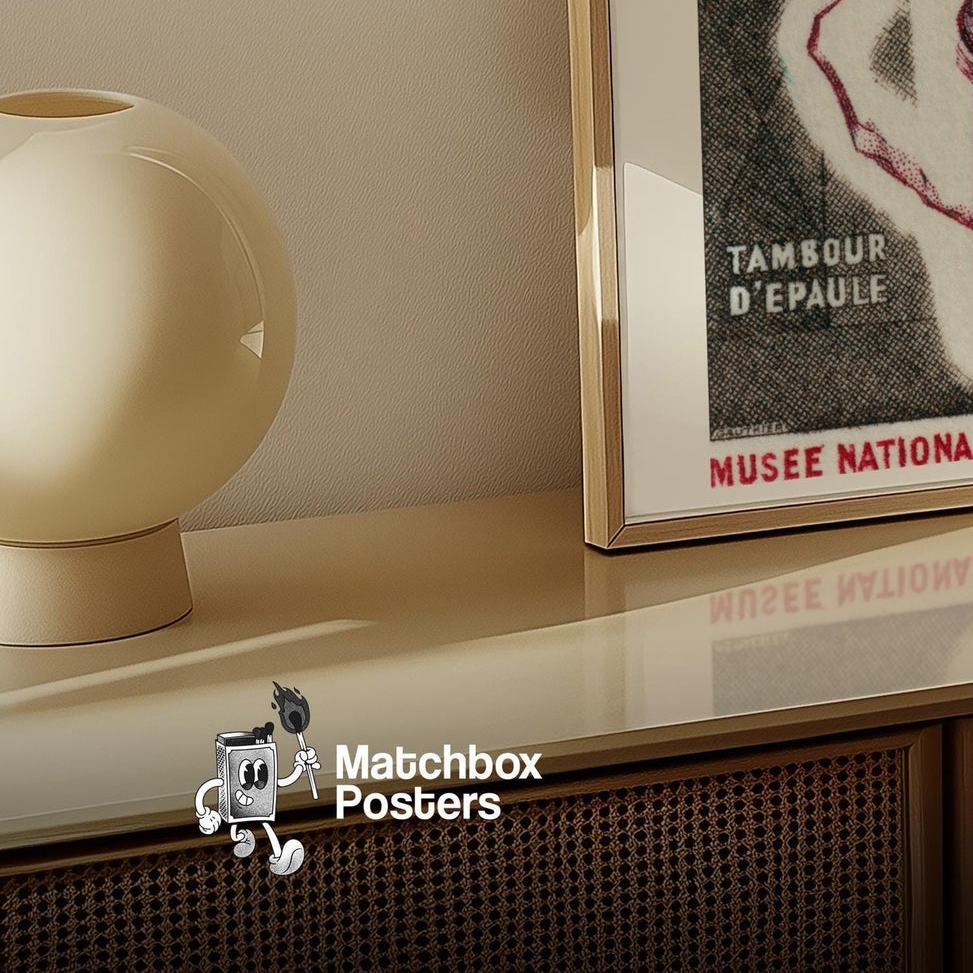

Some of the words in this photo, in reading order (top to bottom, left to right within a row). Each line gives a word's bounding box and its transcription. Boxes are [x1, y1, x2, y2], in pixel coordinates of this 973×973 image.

[726, 234, 886, 274] TAMBOUR
[730, 275, 887, 316] D'EPAULE
[710, 444, 824, 488] MUSEE
